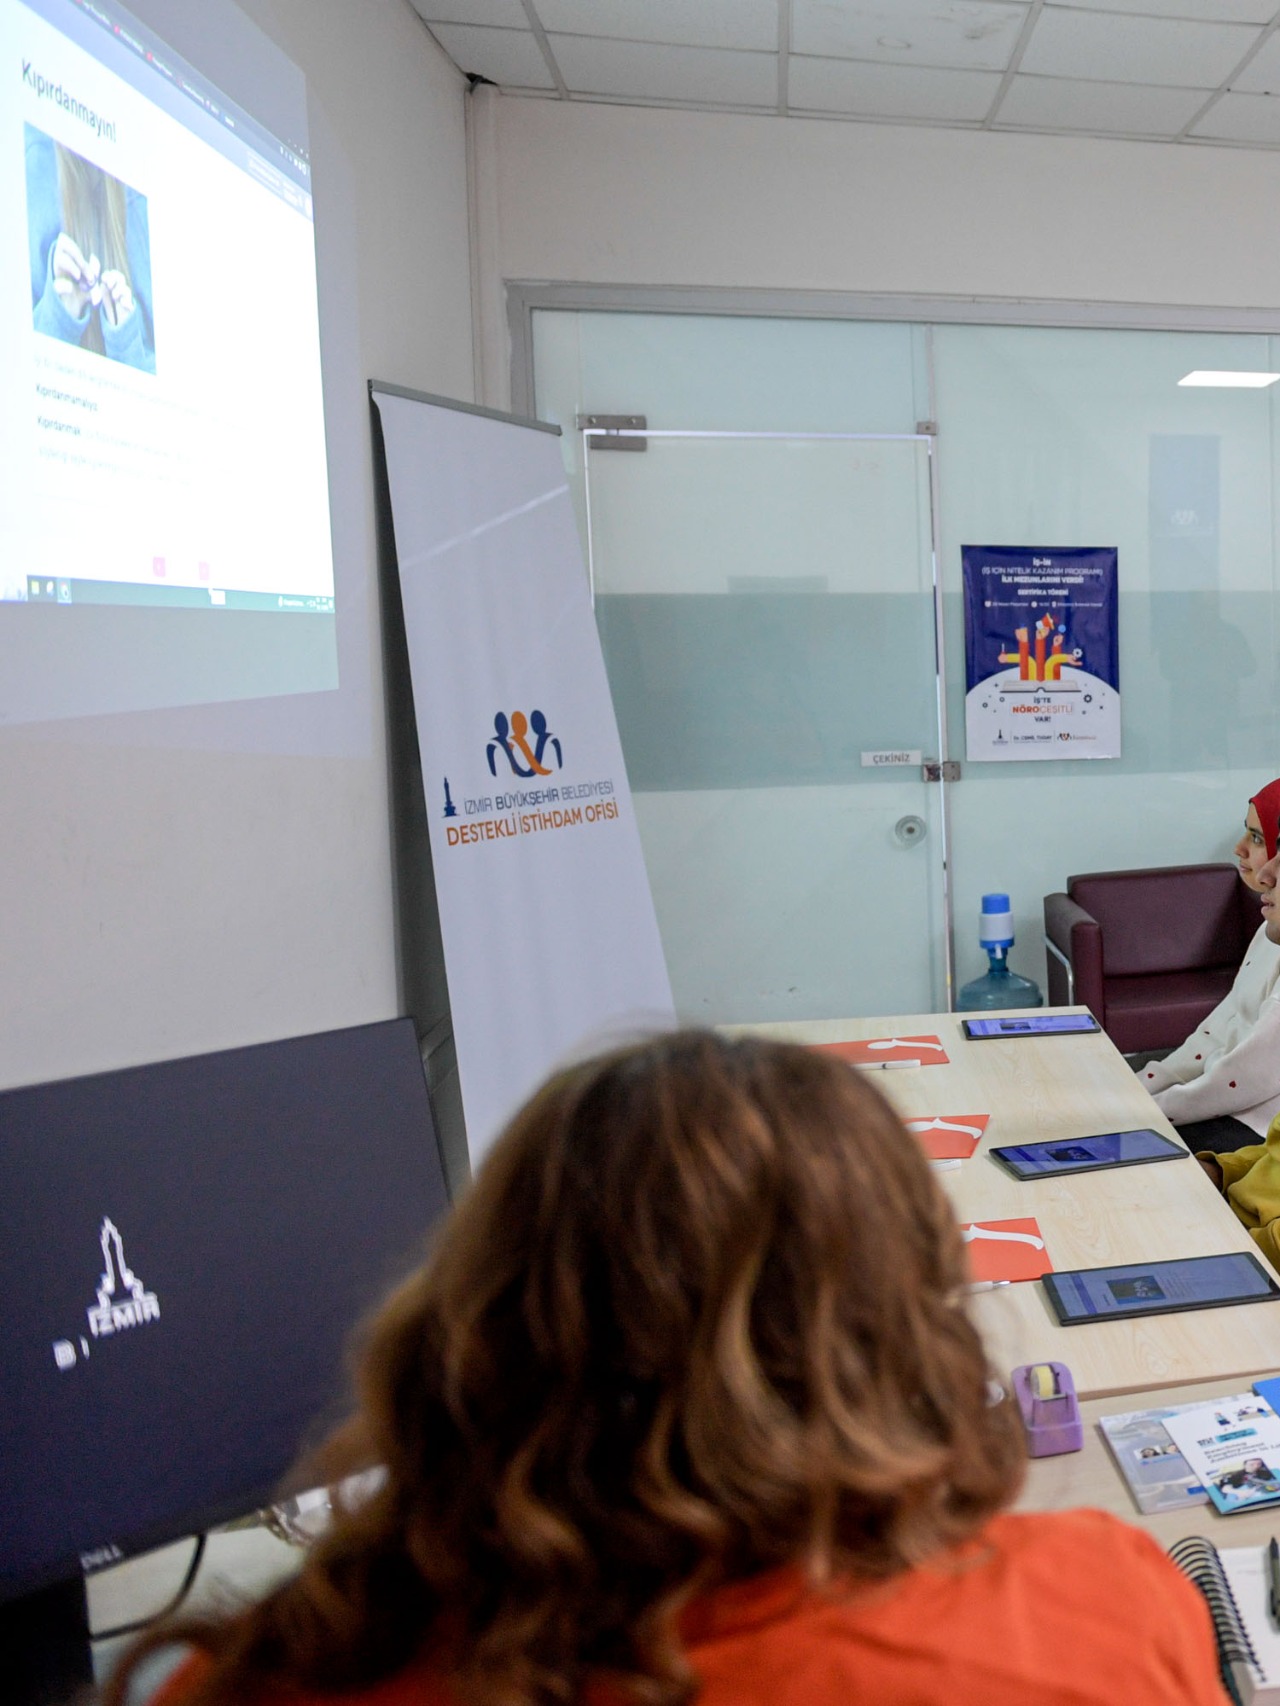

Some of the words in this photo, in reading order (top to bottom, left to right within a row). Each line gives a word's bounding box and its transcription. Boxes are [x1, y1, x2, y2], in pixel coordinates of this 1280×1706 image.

[22, 58, 116, 142] Kıpırdanmayın!
[1033, 567, 1063, 575] KAZANIM
[873, 752, 910, 764] ÇEKİNİZ
[464, 797, 493, 815] İZMİR
[495, 786, 560, 810] BÜYÜKŞEHİR
[561, 780, 614, 801] BELEDİYESİ
[446, 813, 518, 846] DESTEKLİ
[519, 808, 583, 834] İSTİHDAM
[585, 797, 619, 823] OFİSİ
